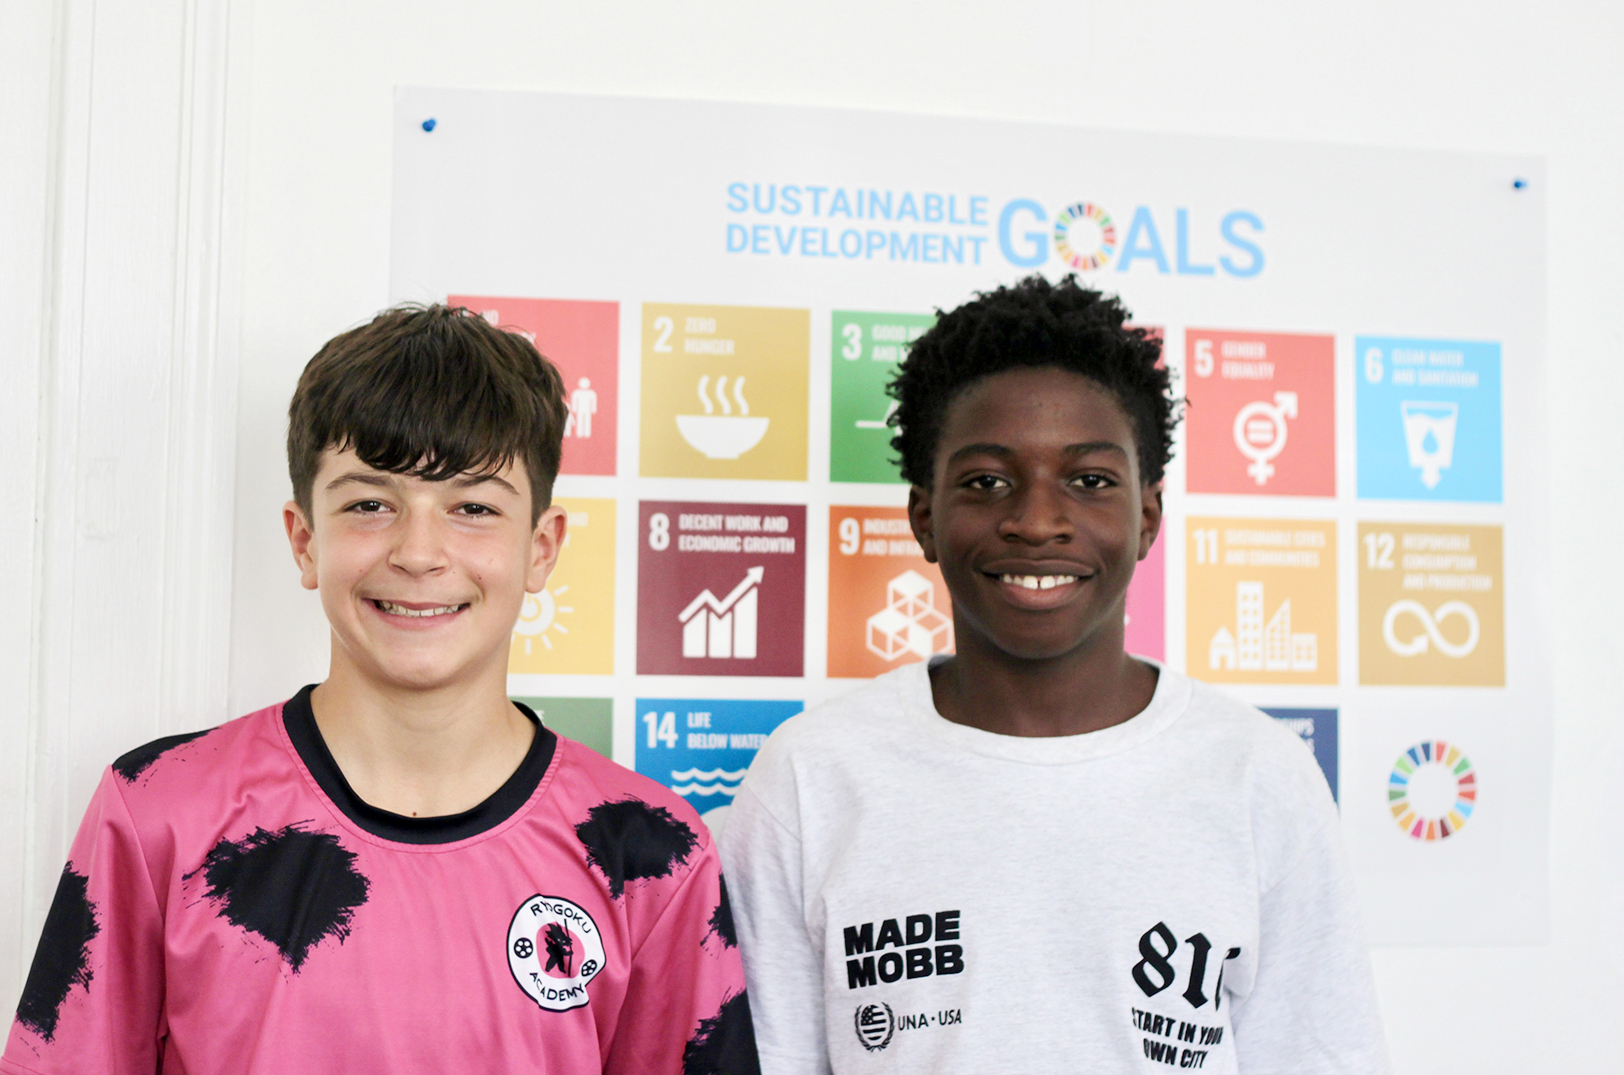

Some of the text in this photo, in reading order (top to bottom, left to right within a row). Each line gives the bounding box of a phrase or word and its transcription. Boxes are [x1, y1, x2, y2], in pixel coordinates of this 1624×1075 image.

[726, 181, 989, 226] SUSTAINABLE
[726, 223, 988, 265] DEVELOPMENT
[653, 315, 674, 353] 2
[842, 322, 863, 361] 3
[1194, 338, 1214, 378] 5
[1363, 346, 1385, 384] 6
[649, 512, 670, 551] 8
[678, 513, 789, 533] DECENT WORK AND
[838, 517, 860, 556] 9
[678, 534, 796, 554] ECONOMIC GROWTH
[1192, 527, 1219, 566] 11
[1362, 531, 1396, 570] 12
[642, 711, 678, 749] 14
[687, 711, 712, 728] LIFE
[687, 732, 728, 749] BELOW
[843, 910, 960, 956] MADE
[846, 944, 964, 989] MOBB
[529, 972, 584, 1001] ACADEMY
[1177, 1021, 1197, 1043] IN
[1143, 1038, 1208, 1069] OWN CITY
